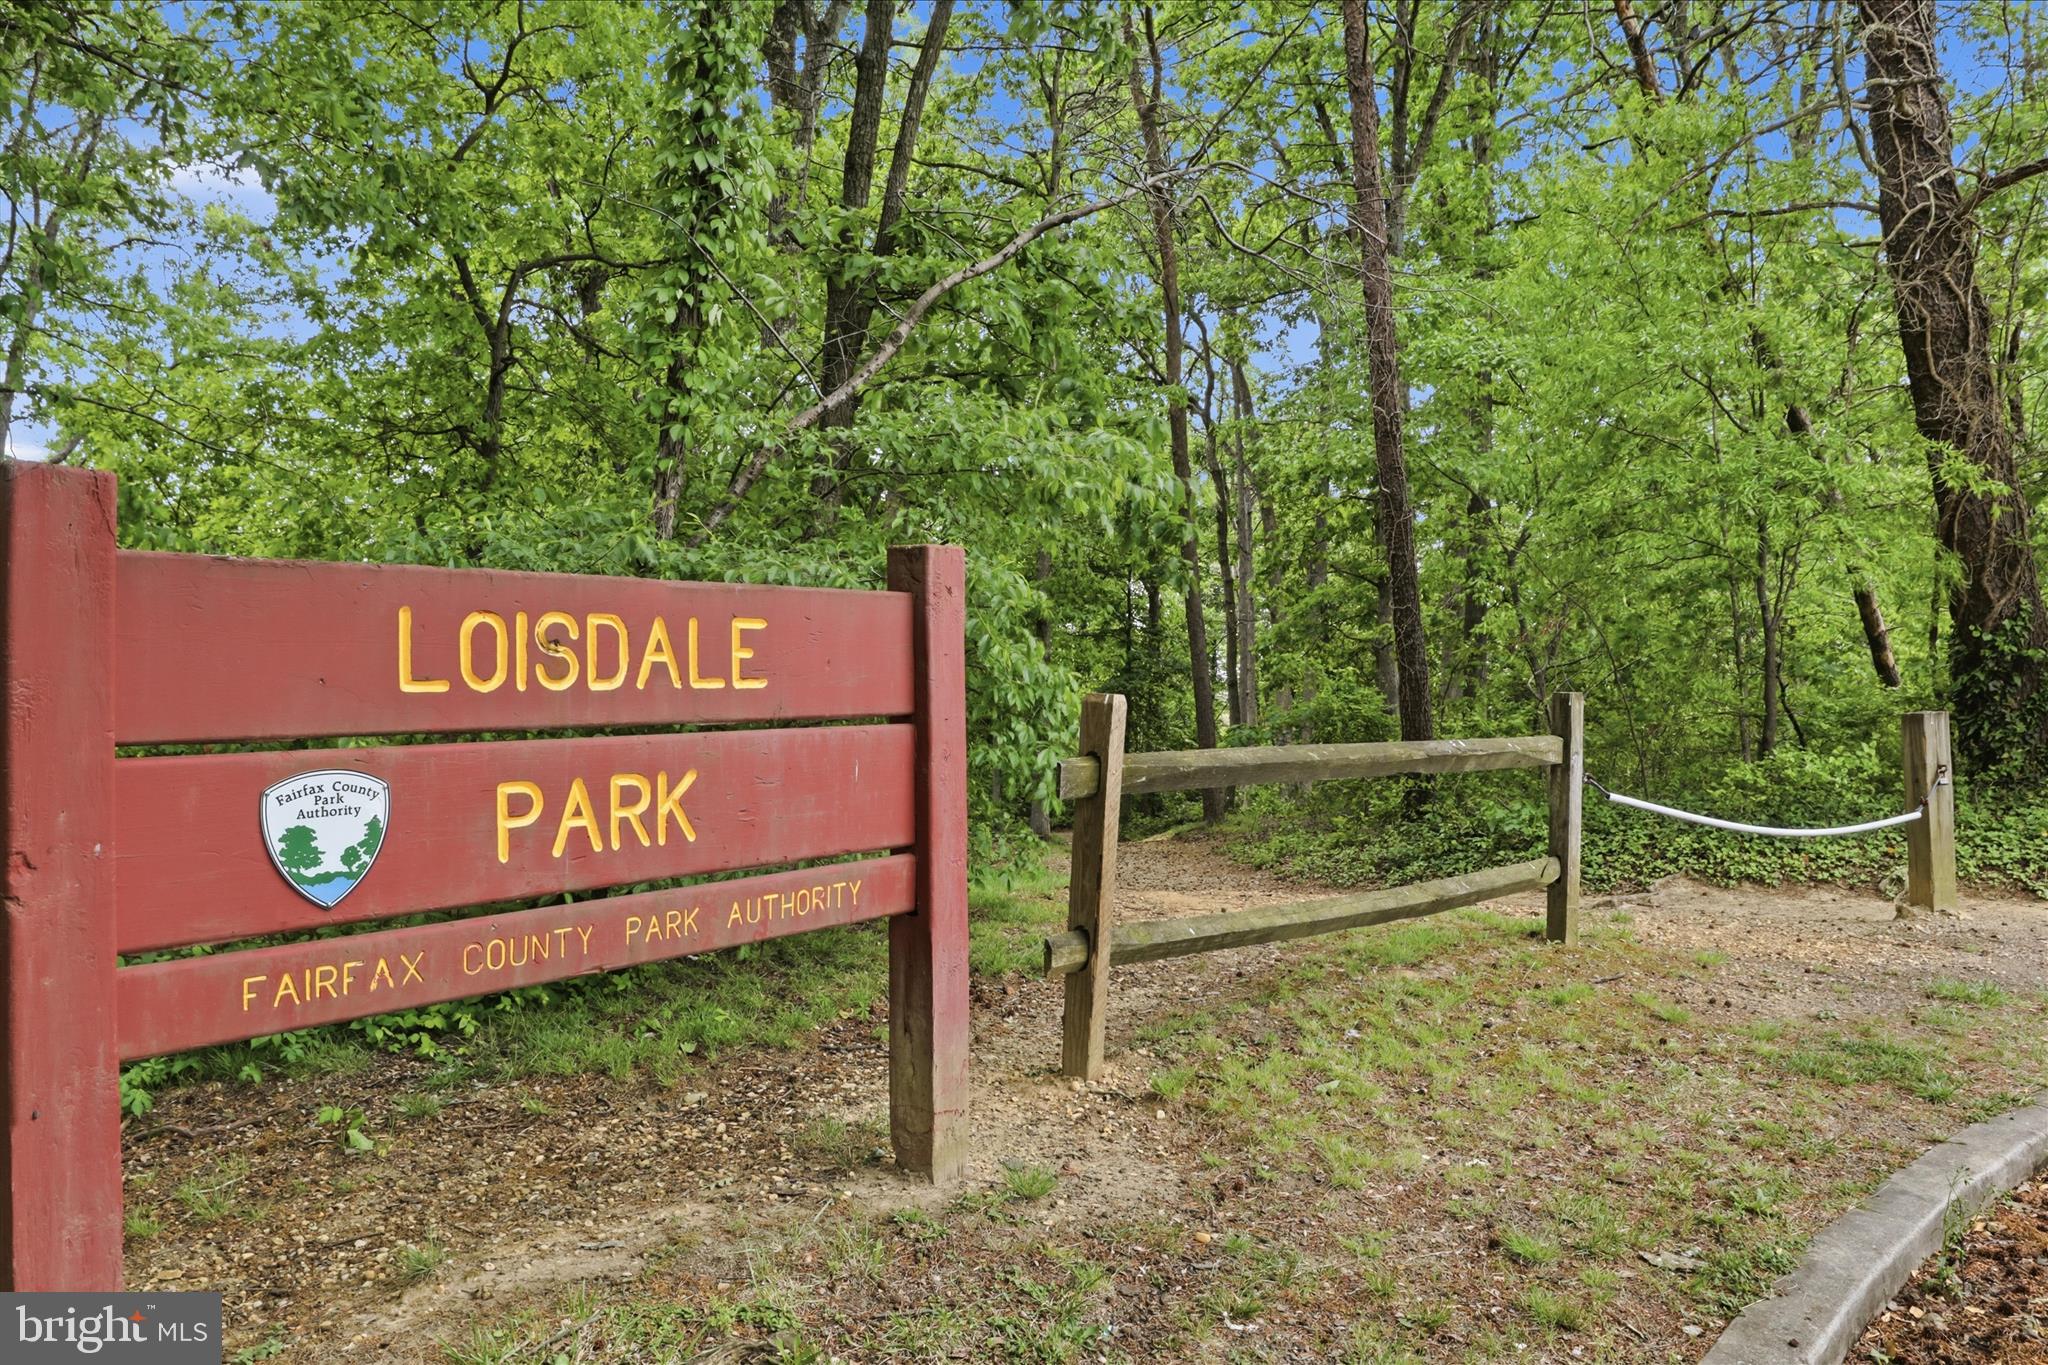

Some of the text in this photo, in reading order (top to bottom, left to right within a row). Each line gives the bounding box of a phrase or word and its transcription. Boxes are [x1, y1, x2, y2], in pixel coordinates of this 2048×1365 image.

[398, 606, 769, 695] LOISDALE
[275, 781, 380, 806] Fairfax County
[296, 805, 362, 820] Authority
[314, 793, 344, 806] Park
[495, 769, 700, 864] PARK
[242, 880, 863, 1011] FAIRFAX COUNTY PARK AUTHORITY
